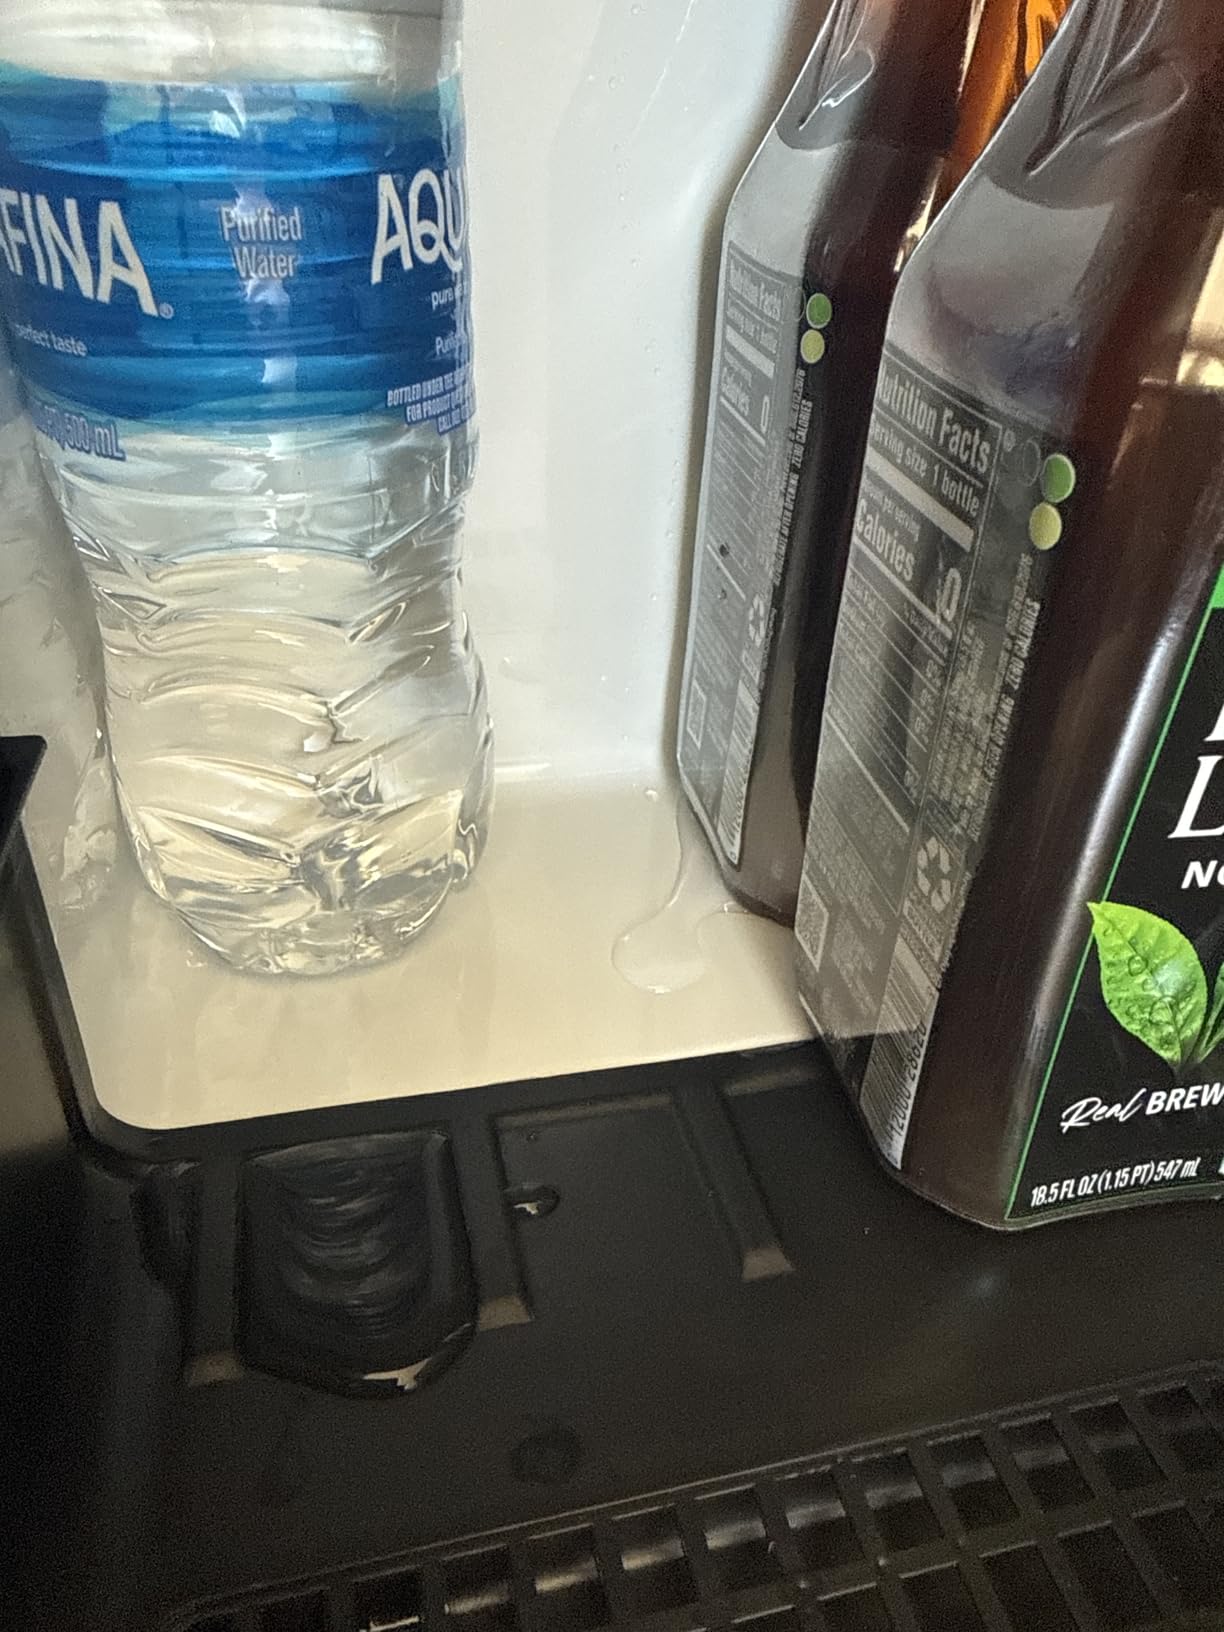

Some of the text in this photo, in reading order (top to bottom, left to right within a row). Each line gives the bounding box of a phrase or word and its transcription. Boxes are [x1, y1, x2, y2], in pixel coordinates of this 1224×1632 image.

[221, 206, 302, 242] Purified
[0, 187, 159, 317] FINA
[233, 246, 296, 278] Water
[51, 331, 88, 357] taste
[387, 383, 422, 408] BOTTLED
[422, 375, 444, 399] UNDER
[406, 403, 422, 423] FOR
[423, 394, 450, 419] PRODUCT
[64, 412, 90, 451] 500
[94, 422, 124, 459] mL
[796, 399, 813, 444] CALORIES
[939, 406, 991, 474] Facts
[791, 443, 805, 469] ZERO
[932, 463, 940, 487] 1
[941, 469, 980, 518] bottle
[856, 498, 915, 582] Calories
[939, 567, 962, 622] 0
[1013, 598, 1041, 659] CALORIES
[1004, 656, 1025, 690] ZERO
[990, 693, 1015, 746] OPENING
[1181, 859, 1224, 890] N
[1060, 1087, 1147, 1134] Real
[1030, 1182, 1060, 1207] 18.5
[1059, 1178, 1077, 1201] FL
[1077, 1172, 1100, 1196] OZ
[1097, 1167, 1131, 1194] (1.15
[1129, 1160, 1156, 1186] PT)
[1153, 1159, 1183, 1182] 547
